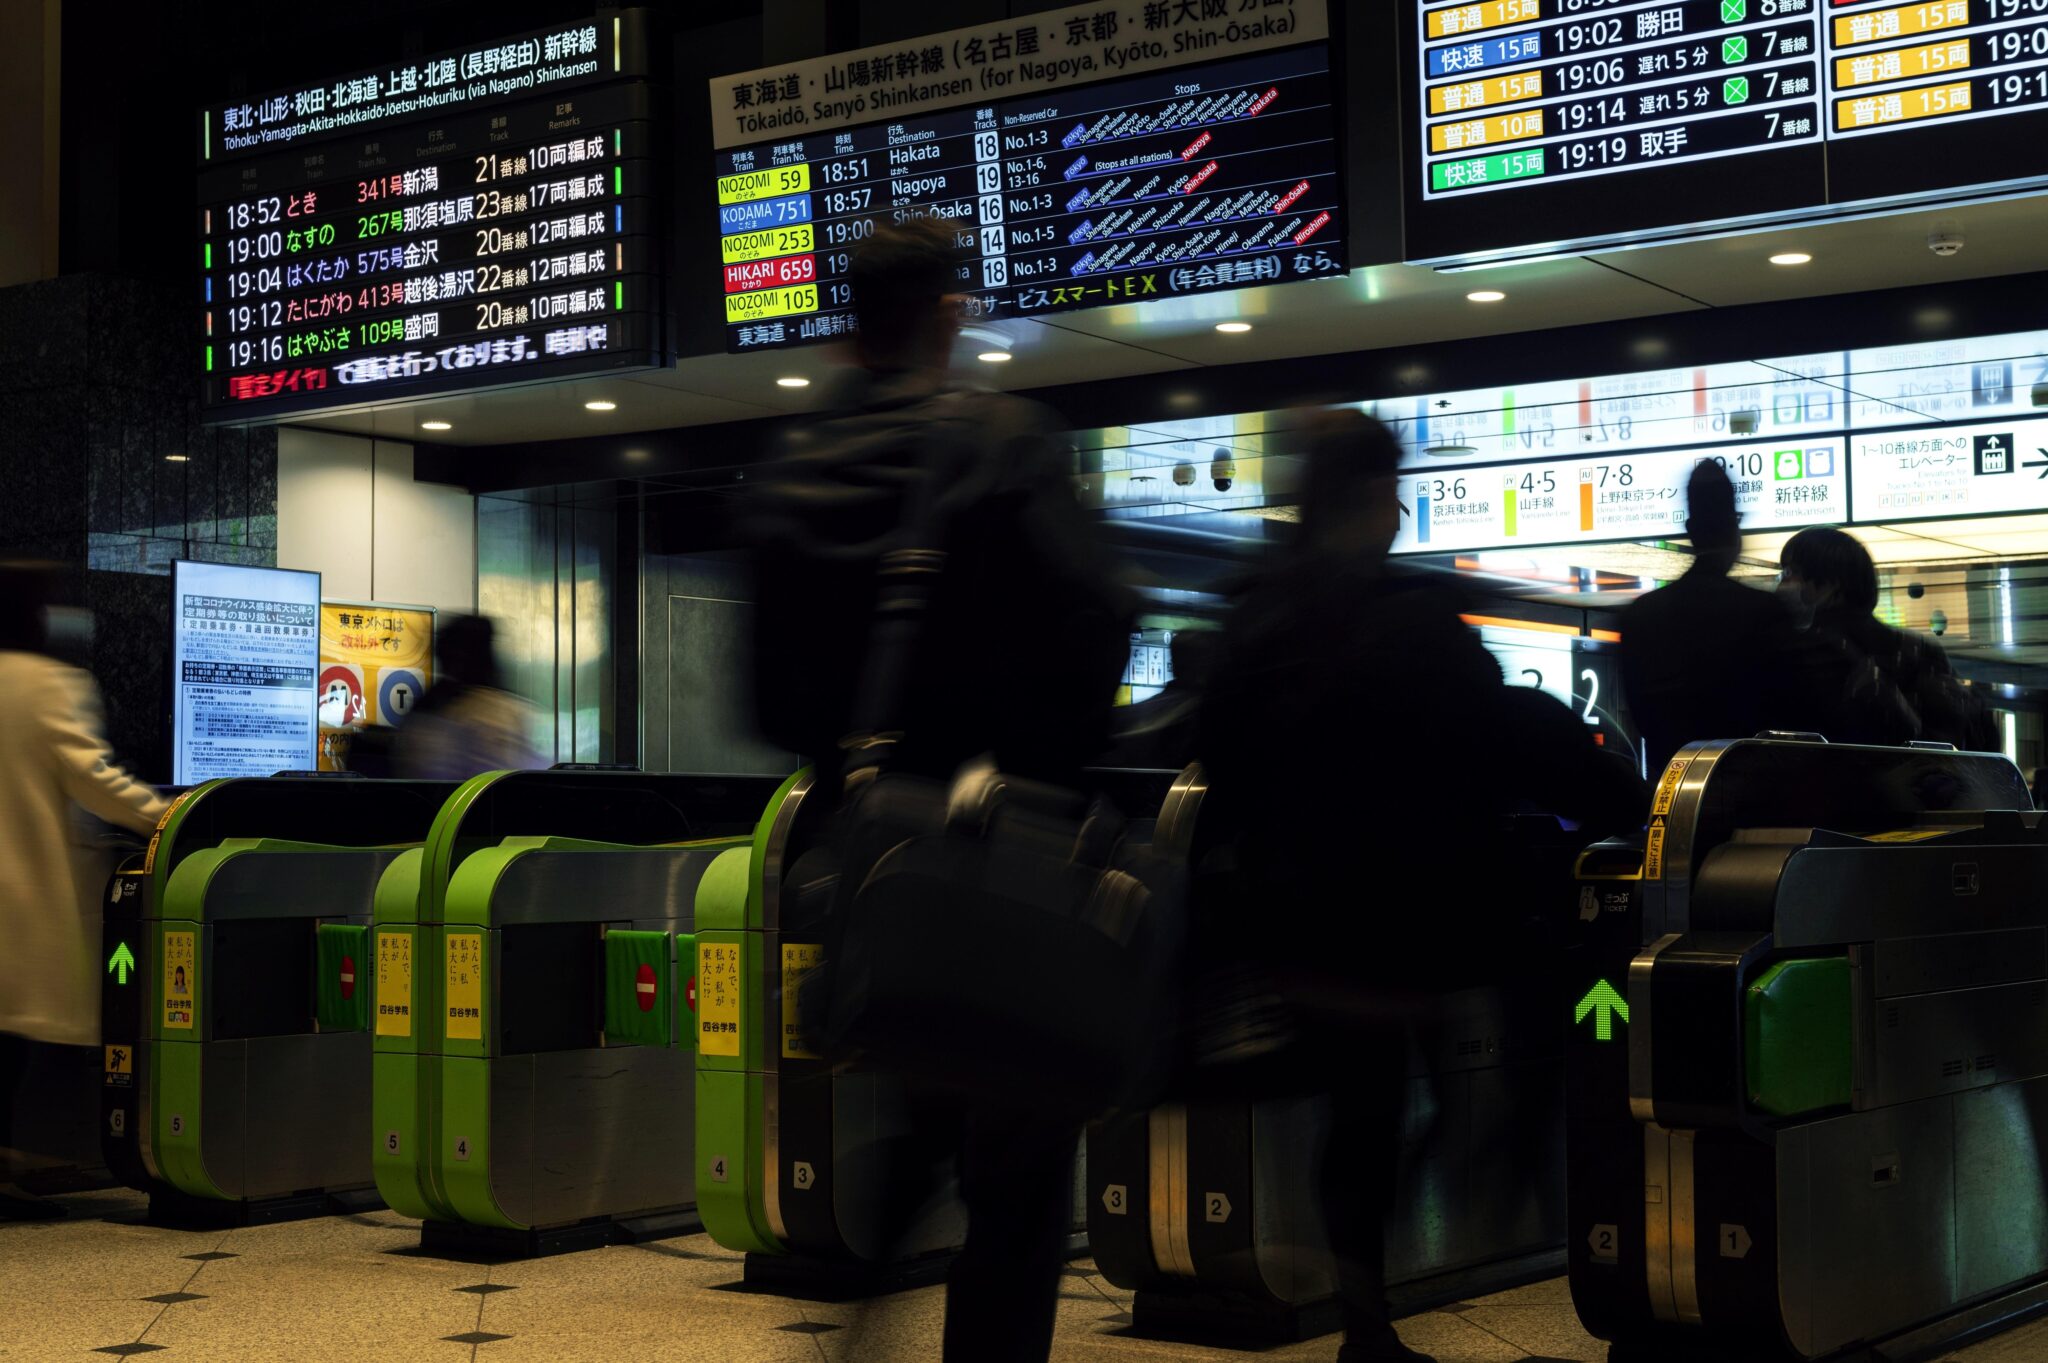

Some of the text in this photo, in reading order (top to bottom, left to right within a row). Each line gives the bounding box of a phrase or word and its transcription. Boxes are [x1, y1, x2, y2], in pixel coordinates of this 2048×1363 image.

[1441, 7, 1683, 72] 快速 15両 19:02 勝田
[736, 9, 1295, 134] Tōkaidō, Sanyō Shinkansen (for Nagoya, Kyōto, Shin-Ōsaka)
[1442, 82, 1485, 111] 普通
[1499, 75, 1540, 99] 15両
[1556, 57, 1625, 91] 19:06
[1762, 31, 1808, 57] 7番線
[1851, 43, 1968, 85] 普通 15両
[468, 83, 486, 100] (via
[490, 71, 534, 94] Nagano)
[536, 60, 597, 84] Shinkansen
[1174, 83, 1200, 95] Stops
[1250, 88, 1278, 115] Hakata
[1444, 121, 1486, 150] 普通
[1500, 114, 1541, 137] 10両
[1557, 97, 1626, 131] 19:14
[1763, 72, 1809, 98] 7番線
[1852, 85, 1970, 127] 普通 15両
[490, 131, 509, 142] Track
[549, 116, 580, 130] Remarks
[771, 108, 1058, 165] Train No. Time Destination Tracks Non-Reserved Car
[835, 133, 852, 145] 時刻
[1182, 133, 1211, 160] Nagoya
[1445, 113, 1811, 187] 快速 15両 19:19 取手 7番線
[720, 131, 1048, 195] NOZOMI 59 18:51 Hakata No.1-3
[1095, 150, 1173, 173] (Stops stations)
[227, 135, 604, 230] 18:52 とき 341号 新潟 21番線 10両編成
[722, 157, 1047, 225] KODAMA 751 18:57 Nagoya 19 No.1-6,
[1008, 173, 1040, 189] 13-16
[1183, 162, 1218, 193] Shin-Ōsaka
[735, 191, 756, 200] のぞみ
[1274, 181, 1309, 213] Shin-Ōsaka
[228, 173, 605, 264] 19:00 なすの 267号 那須塩原 23番線 17両編成
[724, 194, 1052, 253] NOZOMI 253 19:00 Shin-Ōsaka 16 No.1-3
[1152, 201, 1185, 231] Shizuoka
[1294, 214, 1329, 244] Hiroshima
[1215, 230, 1240, 255] Himeji
[1241, 221, 1275, 251] Okayama
[1268, 217, 1301, 248] Fukuyama
[228, 211, 605, 298] 19:04 はくたか 575号 金沢 20番線 12両編成
[727, 226, 1055, 283] HIKARI 659 No.1-5
[229, 249, 606, 333] 19:12 たにがわ 413号 越後湯沢 22番線 12両編成
[728, 258, 1057, 312] NOZOMI 105 18 No.1-3
[229, 288, 606, 367] 19:16 はやぶさ 109号 盛岡 20番線 10両編成
[1581, 471, 1591, 479] JU
[1899, 455, 1967, 469] エレベーター
[1418, 484, 1428, 493] JK
[1505, 477, 1515, 485] JY
[1775, 484, 1829, 504] 新幹線
[1520, 497, 1555, 511] 山手線
[1599, 487, 1678, 505] 上野東京ライン
[1433, 502, 1489, 518] 京浜東北線
[1775, 506, 1835, 519] Shinkansen
[339, 613, 404, 632] 東京メトロは
[396, 689, 407, 709] T
[1581, 668, 1600, 725] 2
[1604, 893, 1629, 905] きっぷ
[1604, 904, 1629, 912] TICKET
[391, 938, 400, 961] 私が
[402, 939, 411, 978] なんで、
[380, 1005, 409, 1016] 四谷学院
[703, 1022, 737, 1033] 四谷学院
[798, 1168, 807, 1184] 3
[1211, 1199, 1222, 1216] 2
[1727, 1231, 1737, 1250] 1
